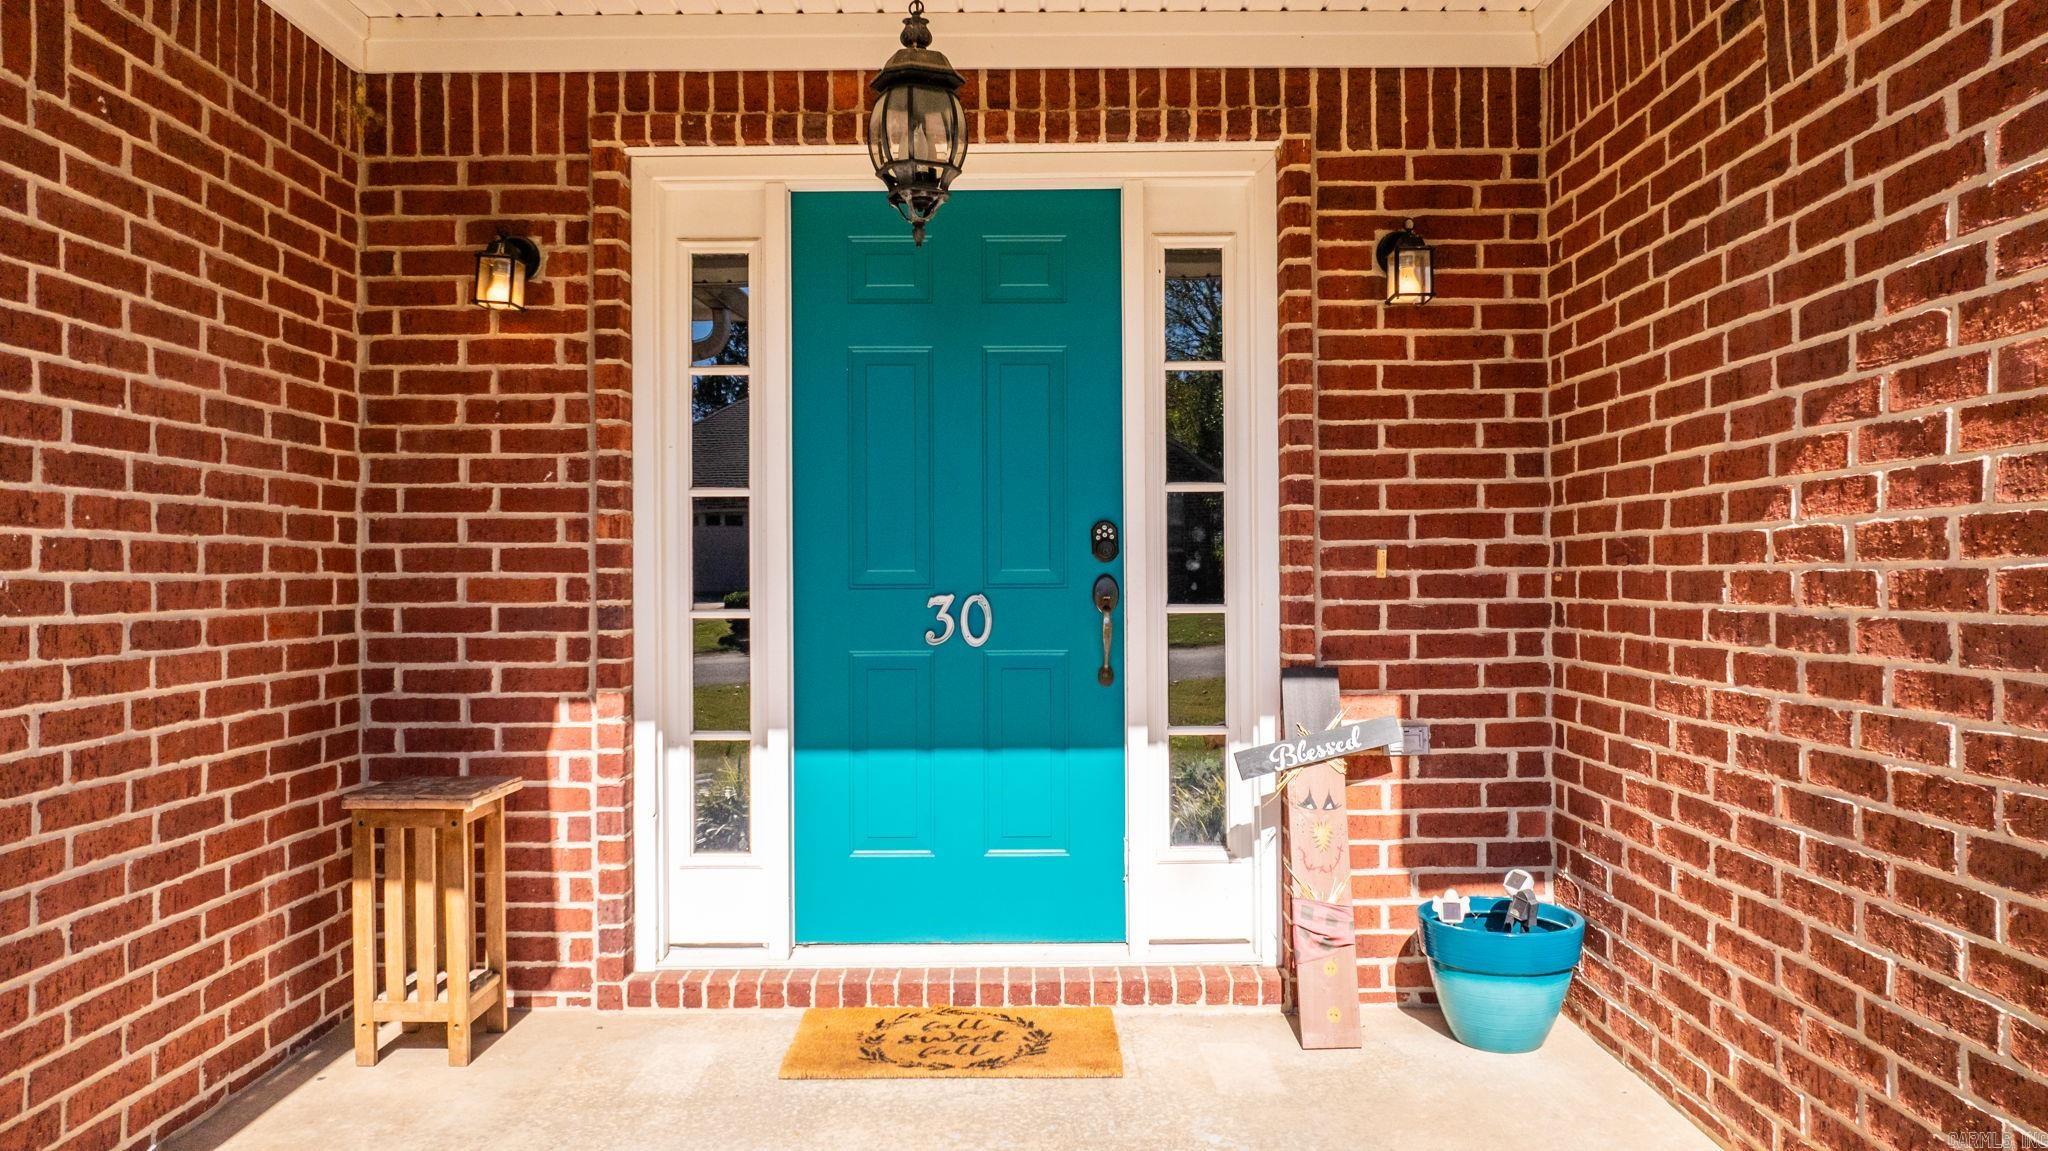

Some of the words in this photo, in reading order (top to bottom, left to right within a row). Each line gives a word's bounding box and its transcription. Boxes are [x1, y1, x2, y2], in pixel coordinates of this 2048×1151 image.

[925, 593, 992, 648] 30
[1268, 725, 1362, 772] Blessed
[898, 1030, 1008, 1044] sweet
